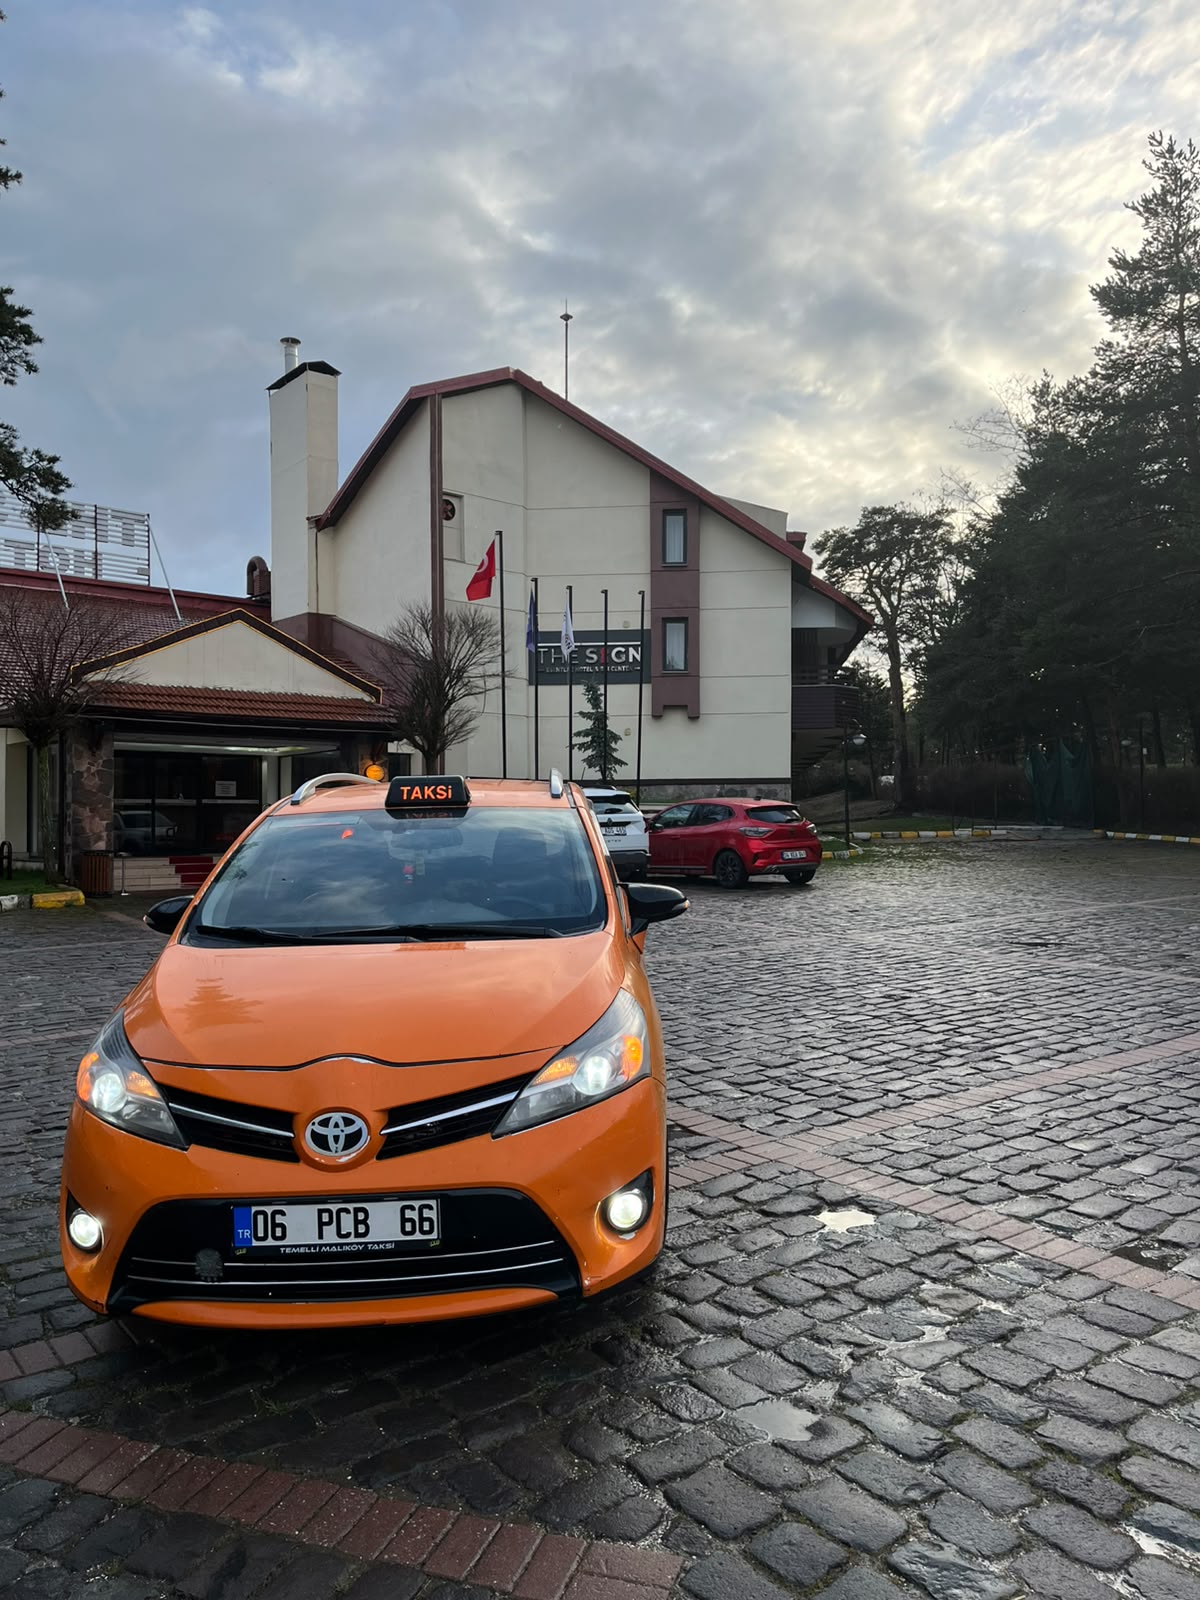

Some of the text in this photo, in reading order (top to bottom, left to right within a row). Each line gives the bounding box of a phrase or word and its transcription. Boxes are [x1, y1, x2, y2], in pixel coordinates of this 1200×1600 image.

[537, 646, 641, 664] THE SIGN
[237, 1203, 435, 1242] TR 06 PCB 66
